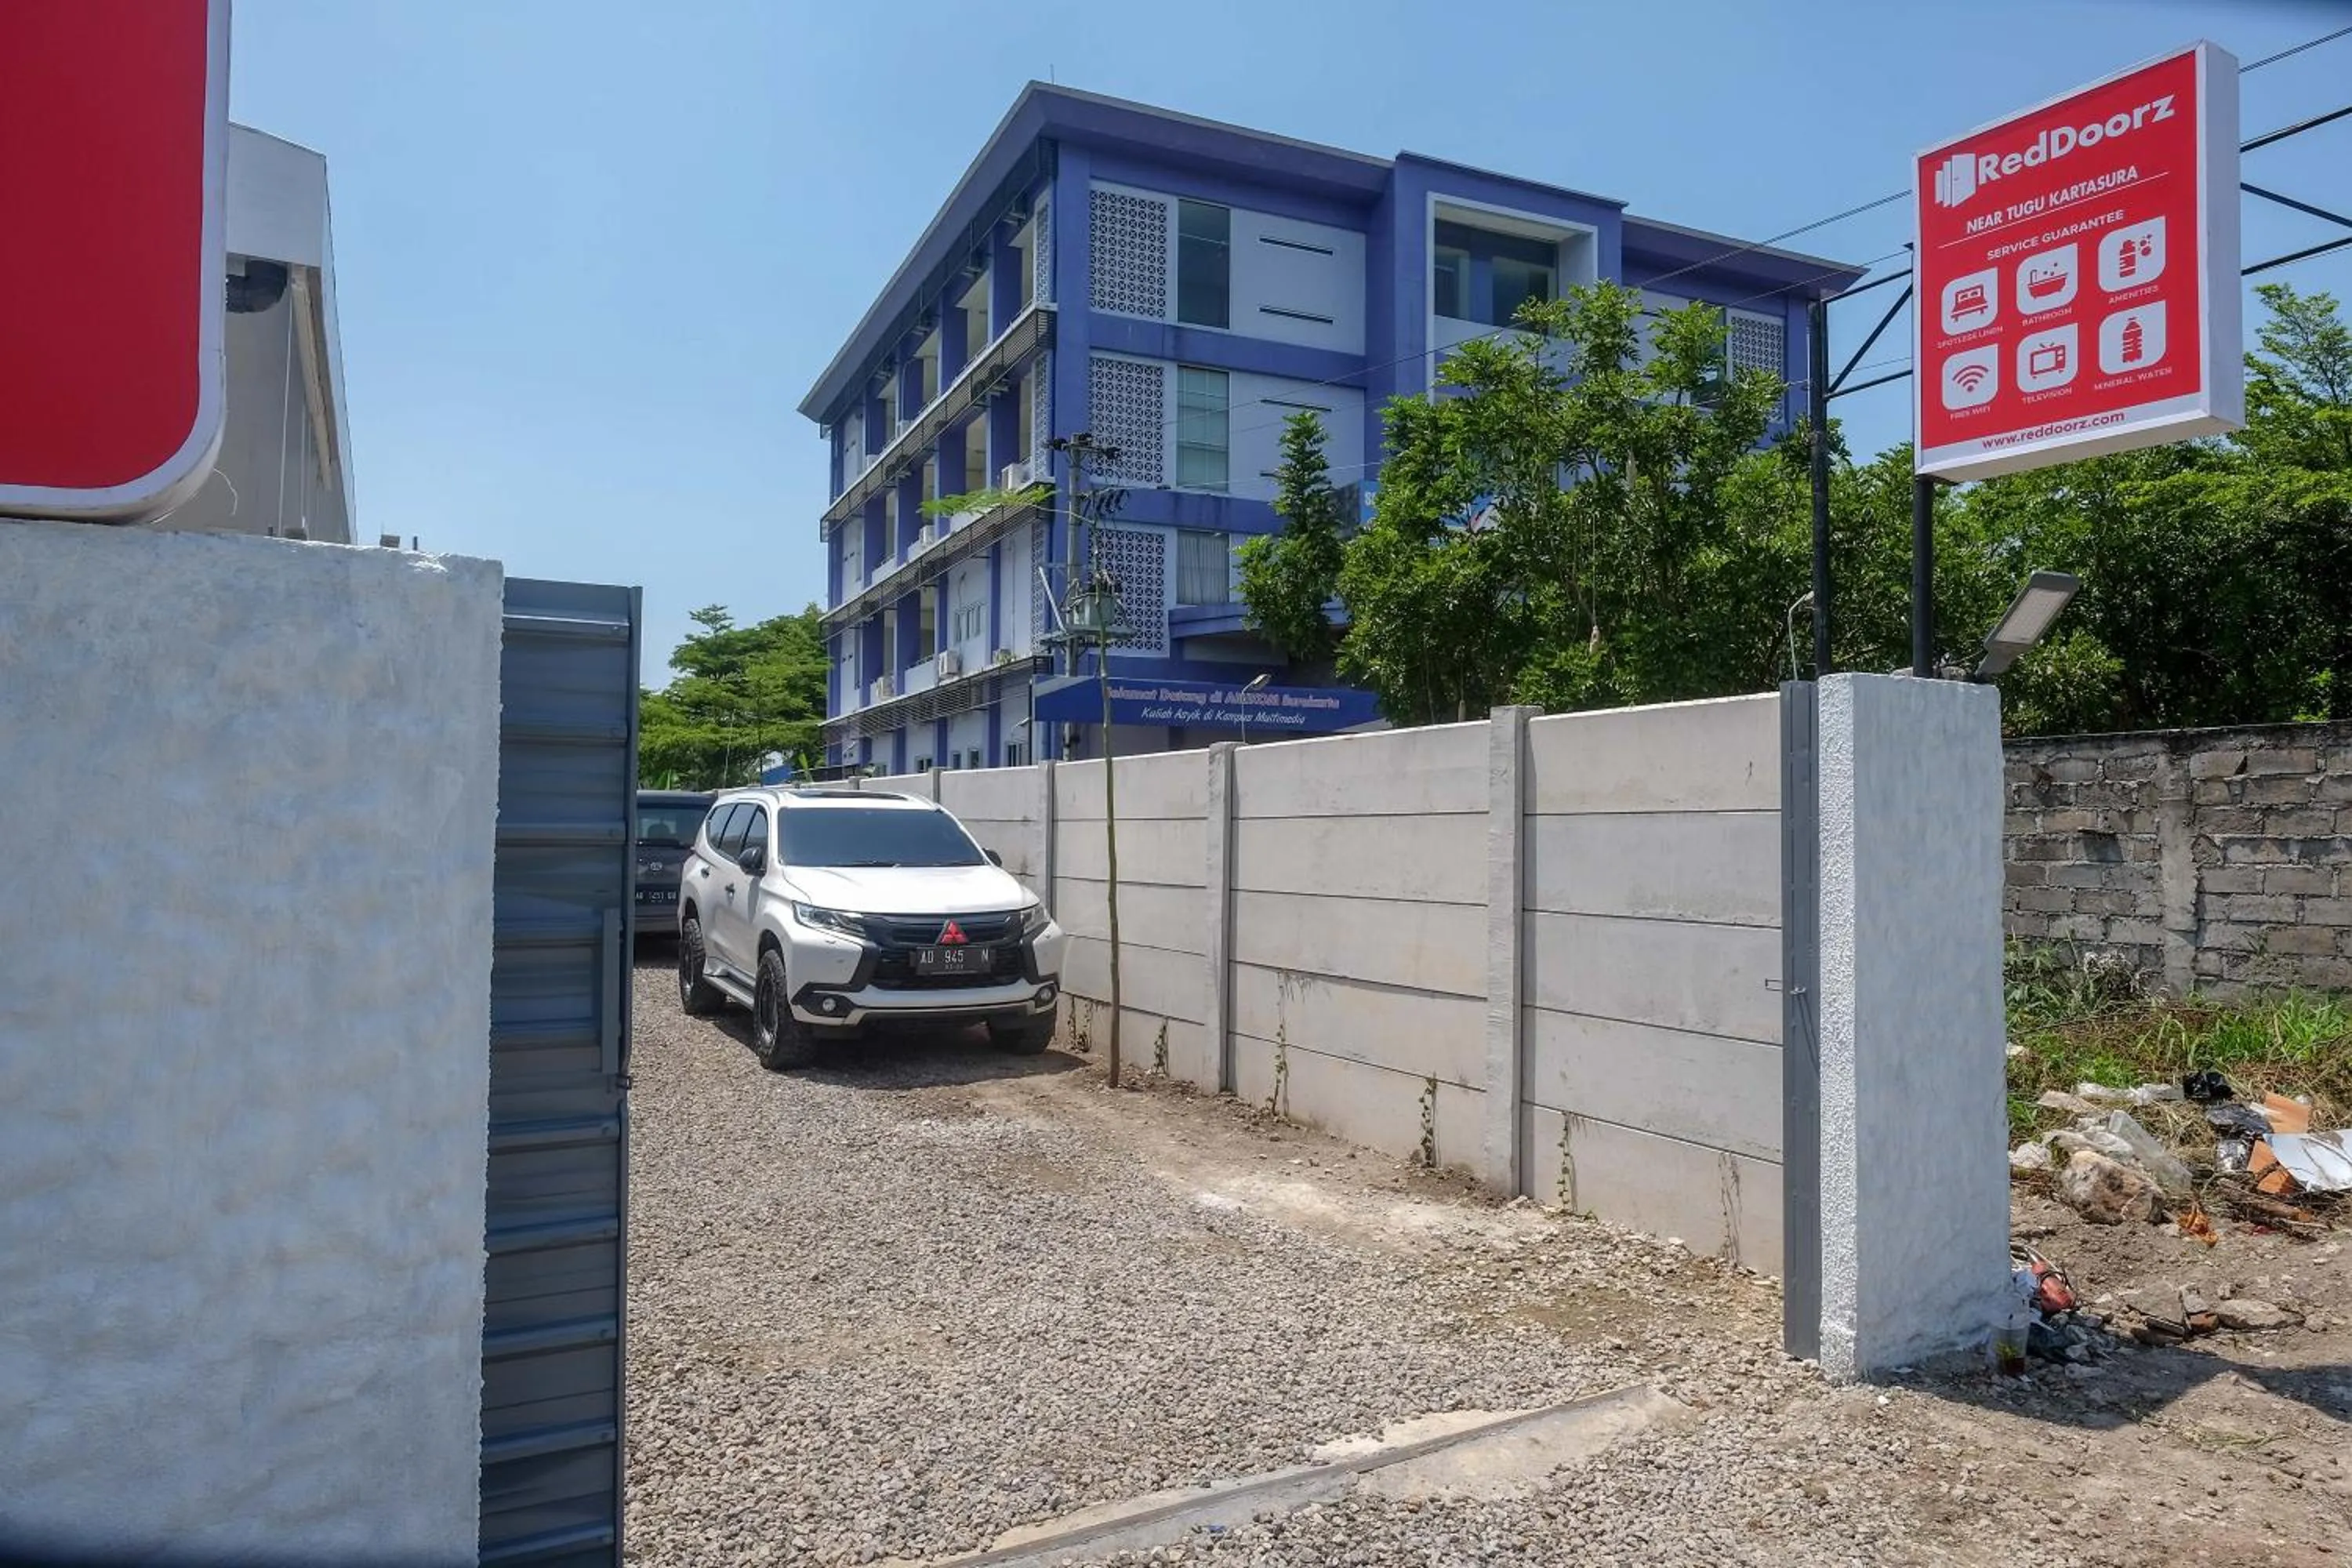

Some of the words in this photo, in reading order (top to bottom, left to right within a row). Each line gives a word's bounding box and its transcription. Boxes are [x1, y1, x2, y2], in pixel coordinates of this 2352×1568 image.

[1978, 94, 2175, 186] RedDoorz
[1966, 211, 2002, 234] NEAR
[2006, 195, 2045, 221] TUGU
[2049, 165, 2138, 208] KARTASURA
[1987, 236, 2039, 261] SERVICE
[2042, 209, 2125, 243] GUARANTEE
[2022, 307, 2072, 327] BATHROOM
[2094, 377, 2134, 390] MINERAL
[2137, 366, 2172, 381] WATER
[2022, 387, 2072, 405] TELEVISION
[1982, 411, 2125, 449] www.reddoorz.com
[920, 950, 934, 964] AD
[945, 950, 964, 964] 945
[981, 948, 989, 963] N
